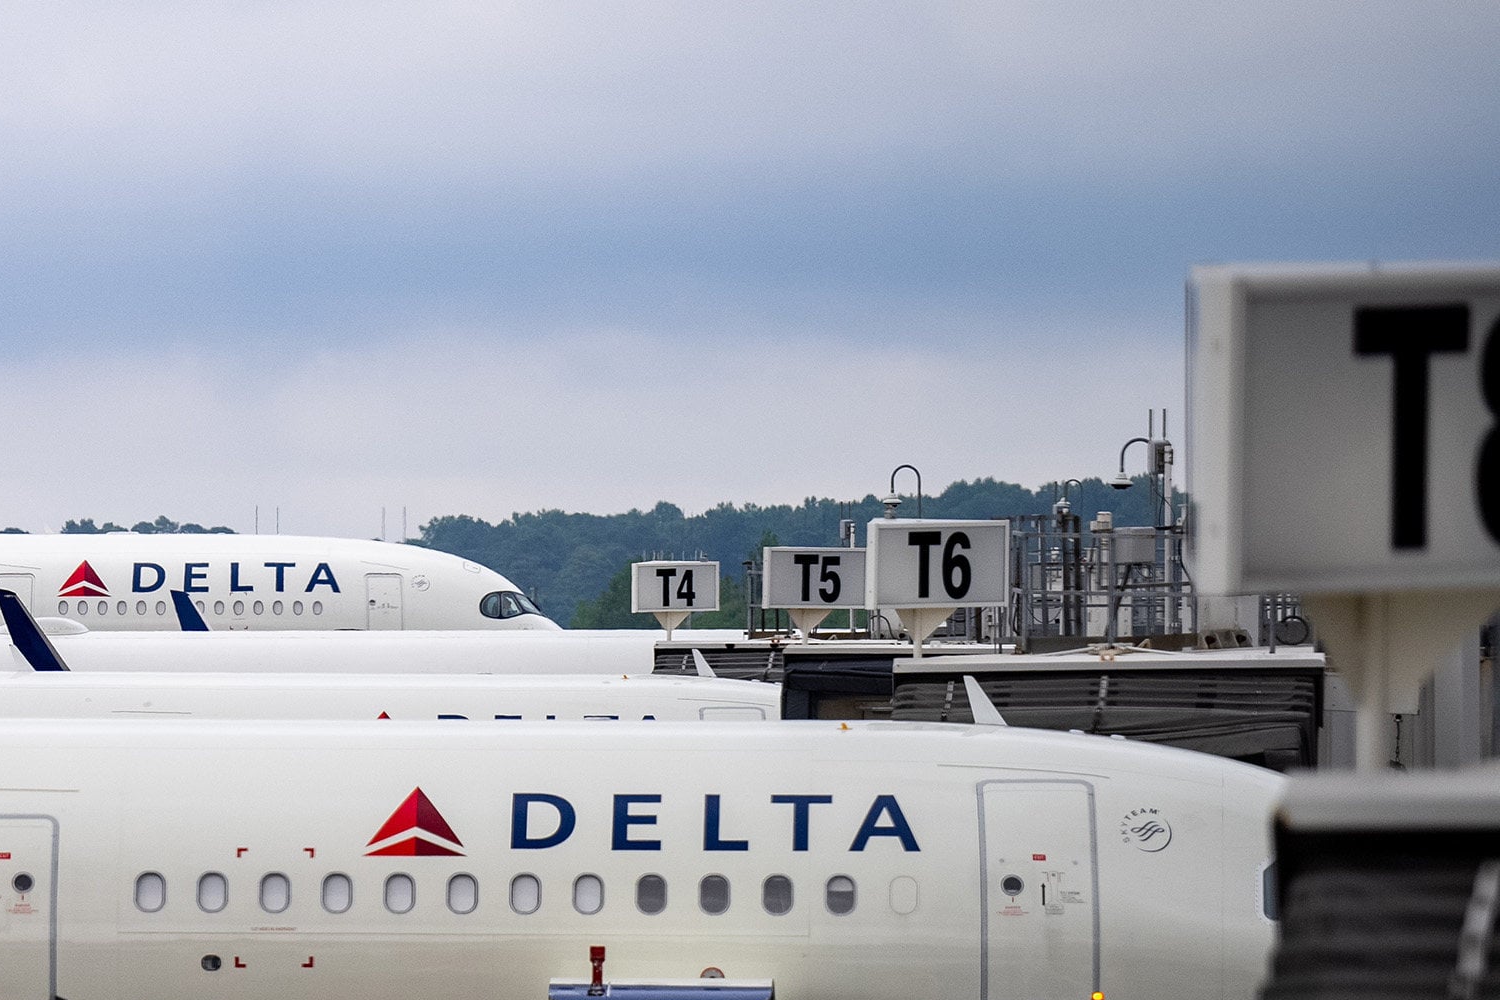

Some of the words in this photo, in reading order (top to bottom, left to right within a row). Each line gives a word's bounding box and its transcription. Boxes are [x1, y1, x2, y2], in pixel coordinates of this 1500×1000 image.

[1350, 297, 1500, 553] T
[131, 562, 341, 594] DELTA
[655, 568, 696, 607] T4
[793, 553, 842, 604] T5
[907, 530, 972, 600] T6
[510, 792, 922, 852] DELTA
